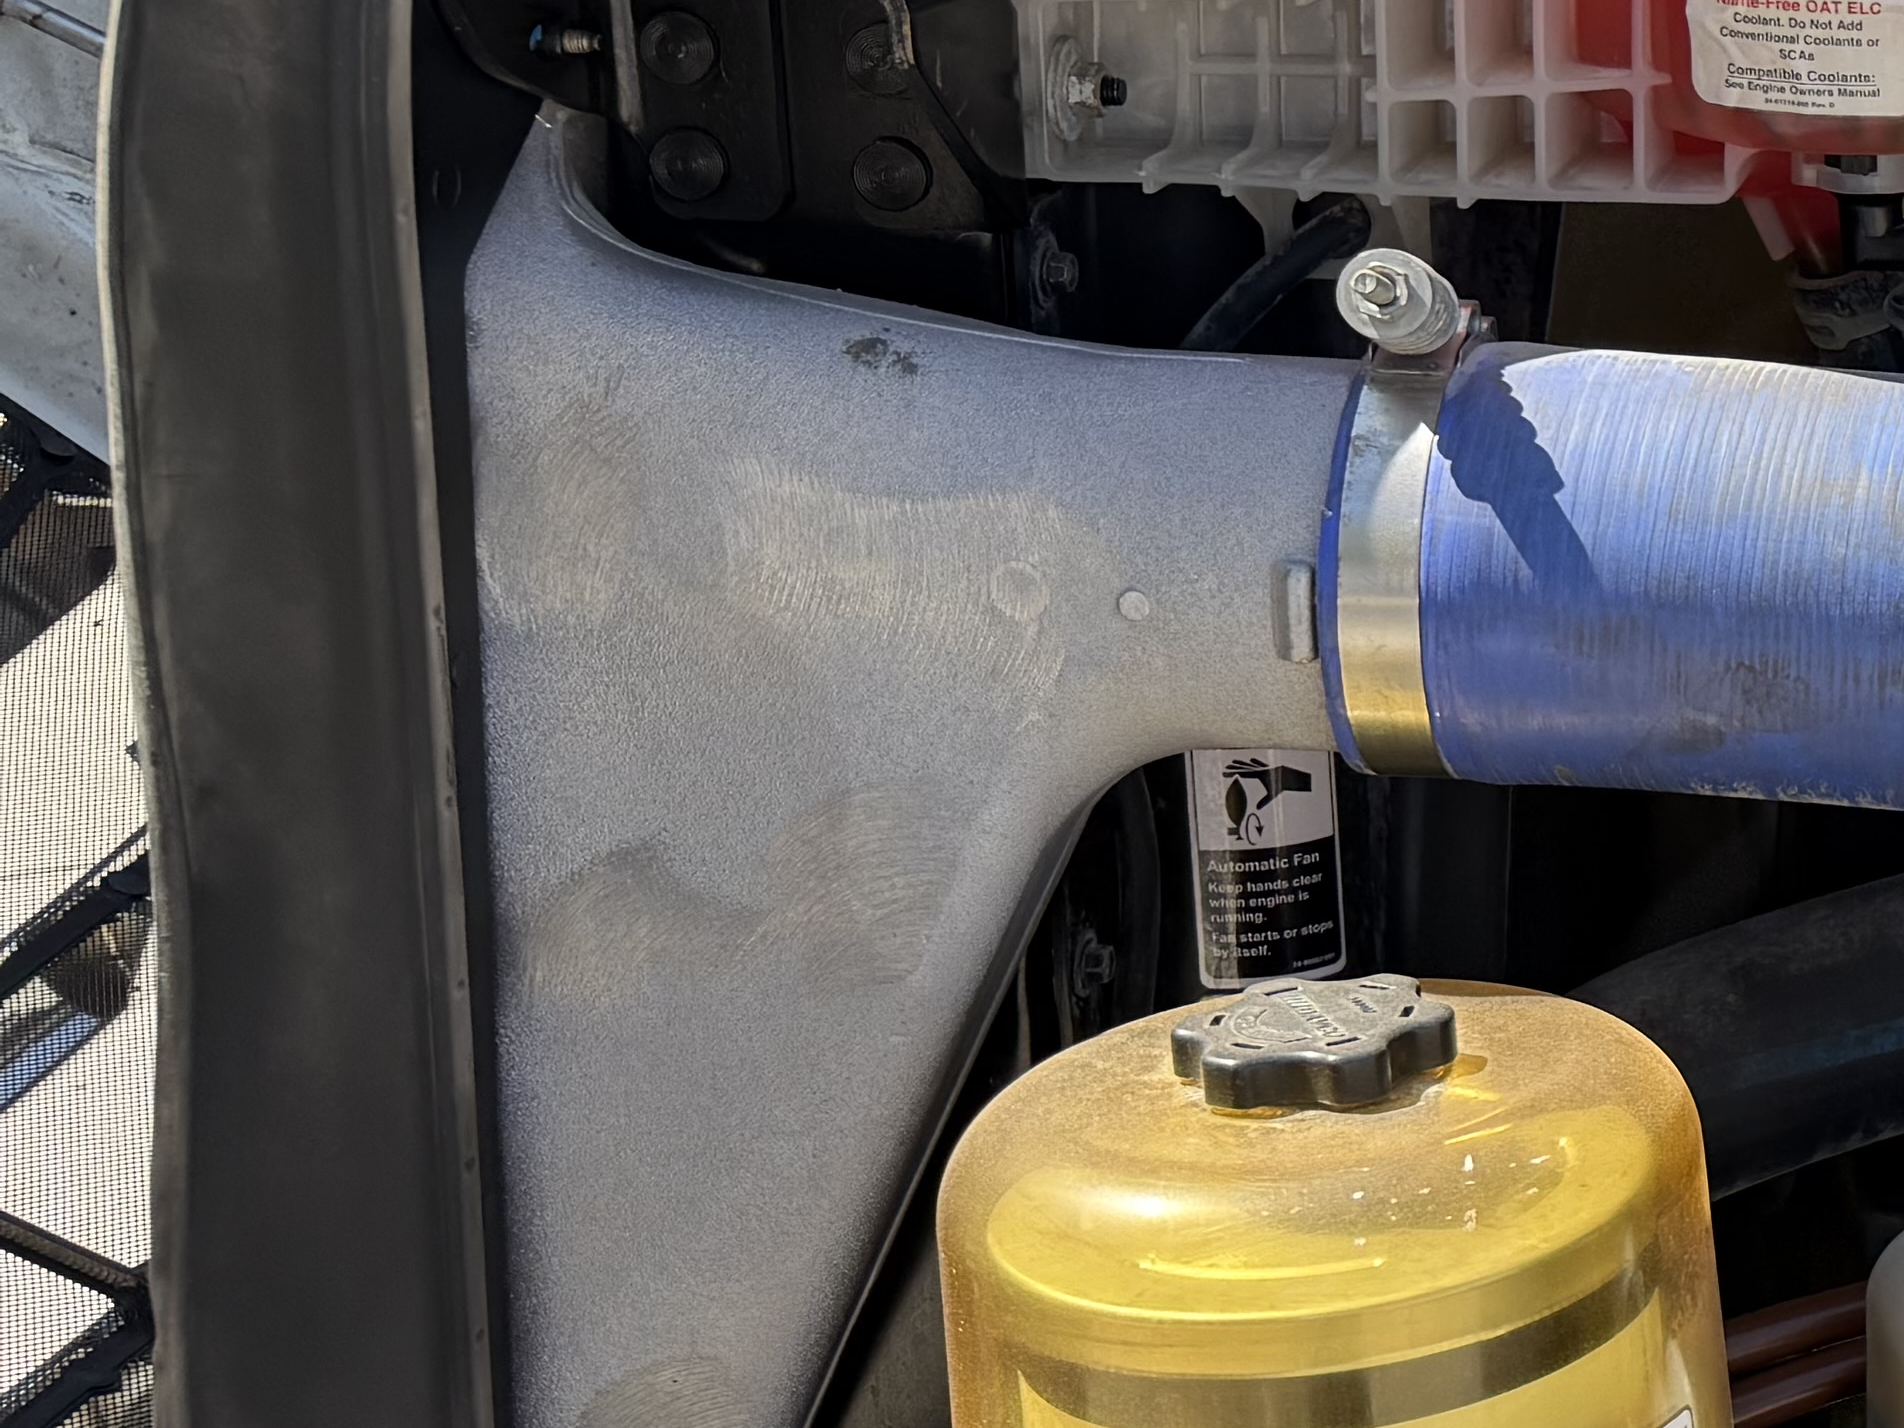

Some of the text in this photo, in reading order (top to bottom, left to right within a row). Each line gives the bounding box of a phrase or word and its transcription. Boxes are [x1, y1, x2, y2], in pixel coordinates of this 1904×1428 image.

[1806, 0, 1842, 14] OAT
[1848, 2, 1882, 15] ELC
[1733, 13, 1862, 31] Coolant. Do Not Add
[1720, 27, 1879, 47] Conventional Coolants or
[1779, 49, 1815, 61] SCAs
[1727, 64, 1876, 83] Compatible Coolants:
[1725, 79, 1880, 97] See Engine Owners Manual
[1207, 853, 1320, 872] Automatic Fan
[1208, 873, 1323, 894] Keep hands clear
[1209, 892, 1309, 908] when engine is
[1211, 912, 1267, 924] running.
[1240, 930, 1280, 942] starts
[1284, 929, 1297, 938] or
[1301, 920, 1334, 936] stops
[1213, 948, 1229, 959] by
